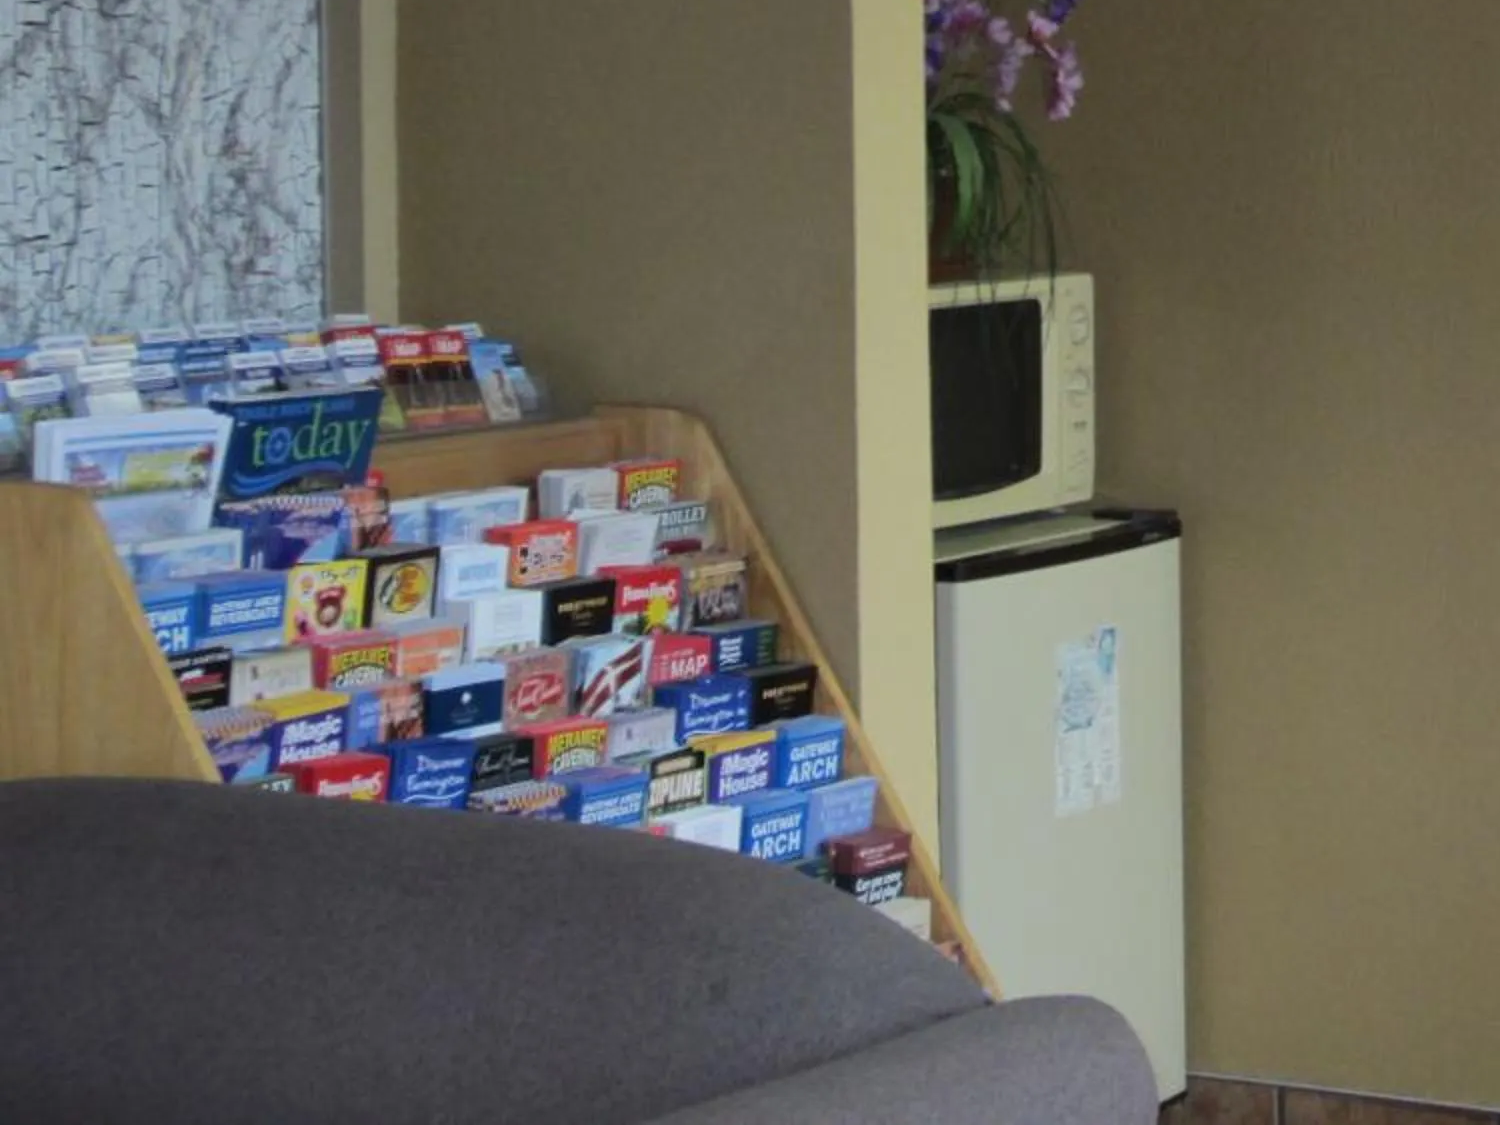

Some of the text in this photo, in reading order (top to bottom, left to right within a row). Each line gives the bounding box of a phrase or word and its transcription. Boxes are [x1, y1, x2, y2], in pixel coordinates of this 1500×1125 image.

[253, 399, 371, 469] today
[720, 747, 769, 777] Magic
[789, 739, 840, 763] GATEWAY
[719, 770, 769, 799] House
[786, 754, 839, 787] ARCH
[751, 812, 803, 838] GATEWAY
[751, 829, 802, 859] ARCH
